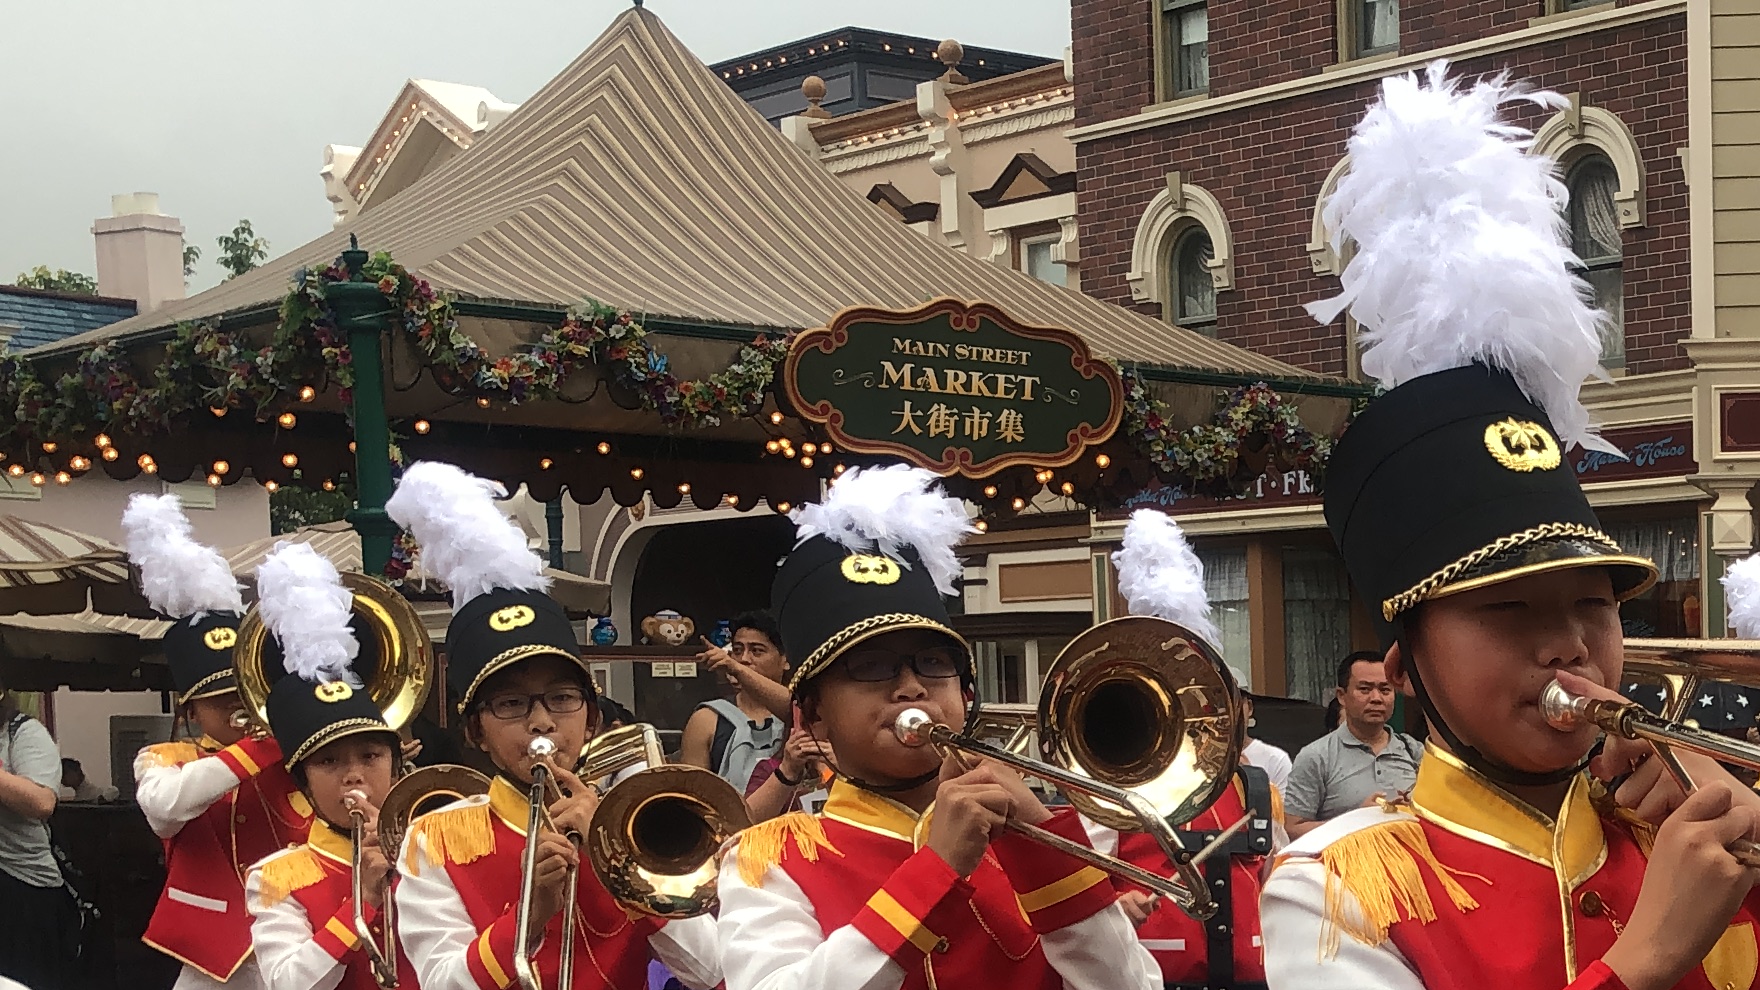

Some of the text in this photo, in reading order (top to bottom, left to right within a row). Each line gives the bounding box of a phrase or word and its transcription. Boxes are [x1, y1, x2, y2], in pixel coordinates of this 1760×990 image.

[892, 337, 1031, 366] MAIN STREET
[878, 360, 1041, 401] MARKET
[891, 400, 1026, 443] 大街市集
[1634, 437, 1686, 467] House
